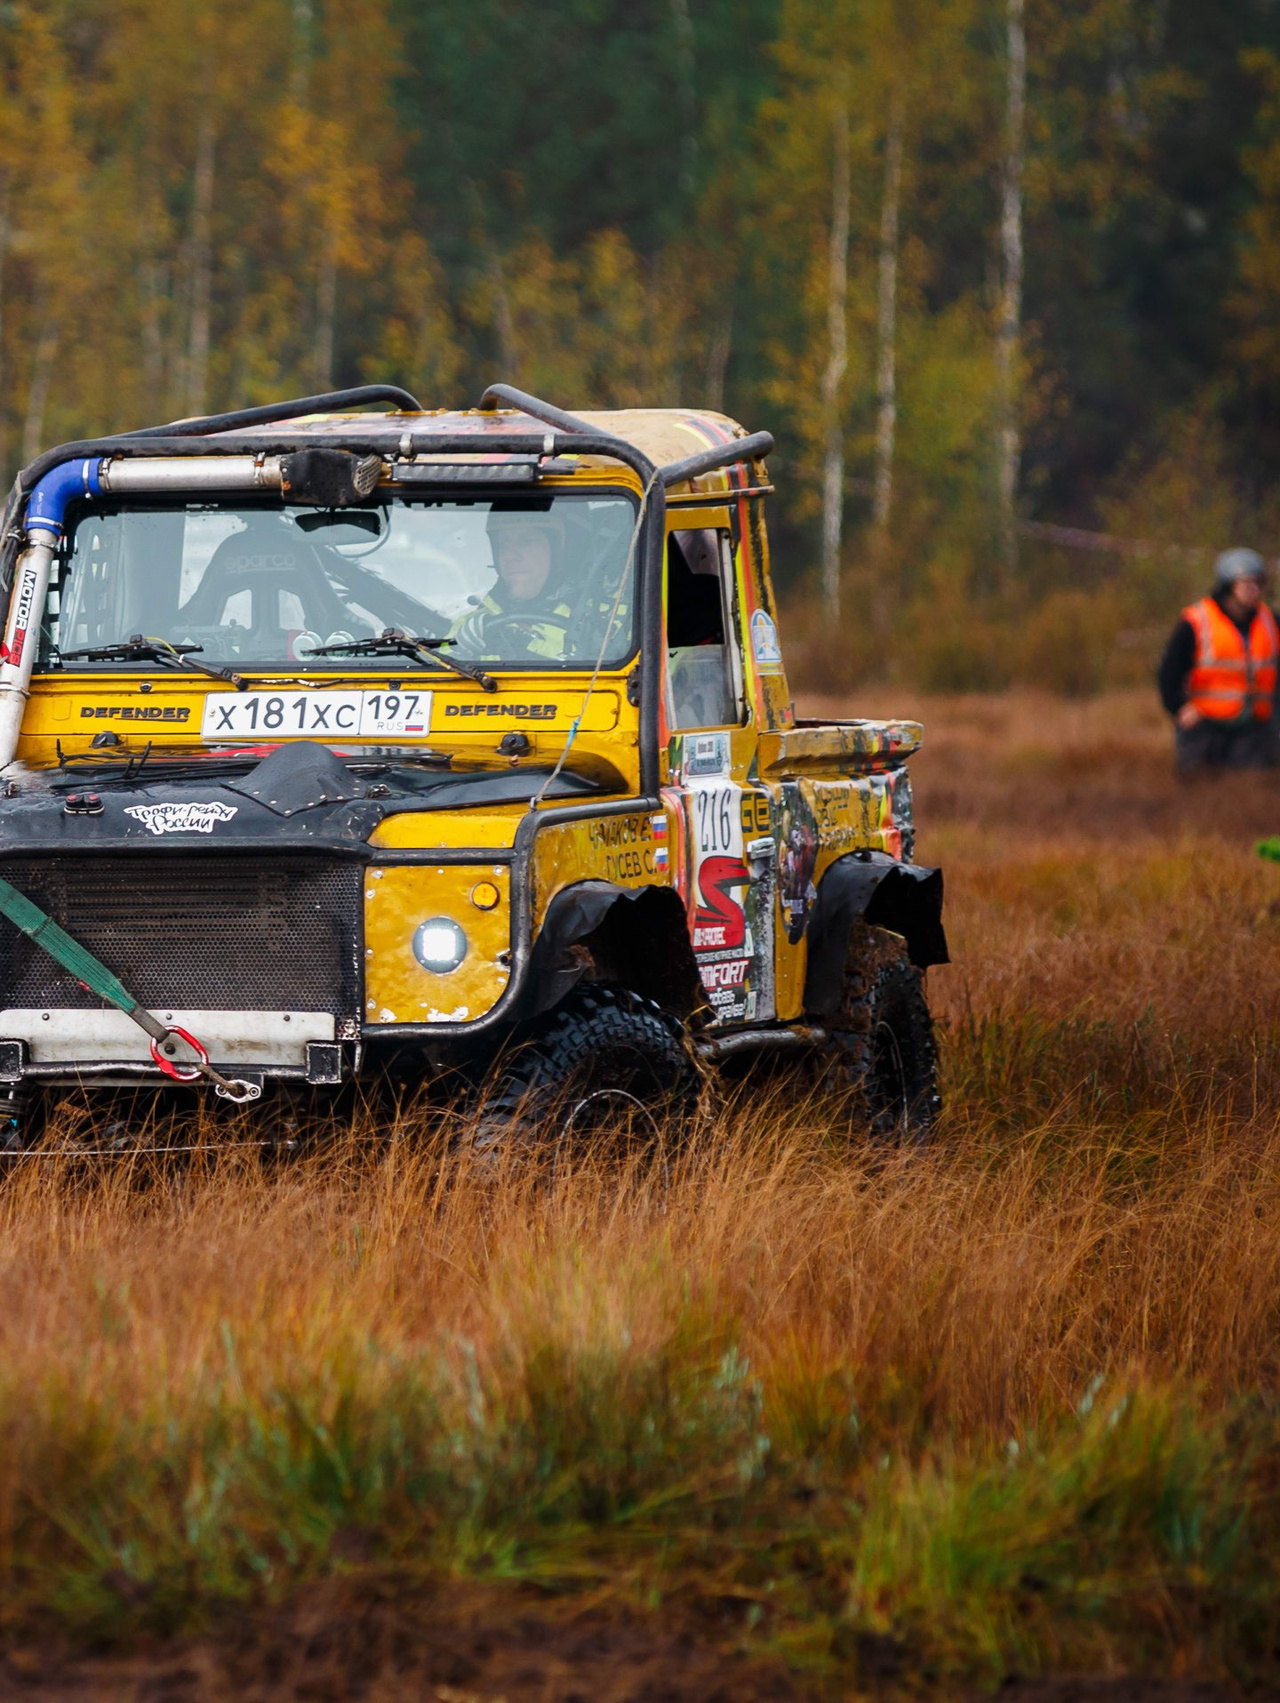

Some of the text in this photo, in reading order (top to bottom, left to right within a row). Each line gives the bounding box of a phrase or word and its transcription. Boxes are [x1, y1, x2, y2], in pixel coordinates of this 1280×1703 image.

[80, 706, 191, 719] DEFENDER
[368, 695, 420, 720] 197
[445, 704, 558, 717] DEFENDER
[377, 721, 404, 731] RUS
[698, 789, 731, 852] 216
